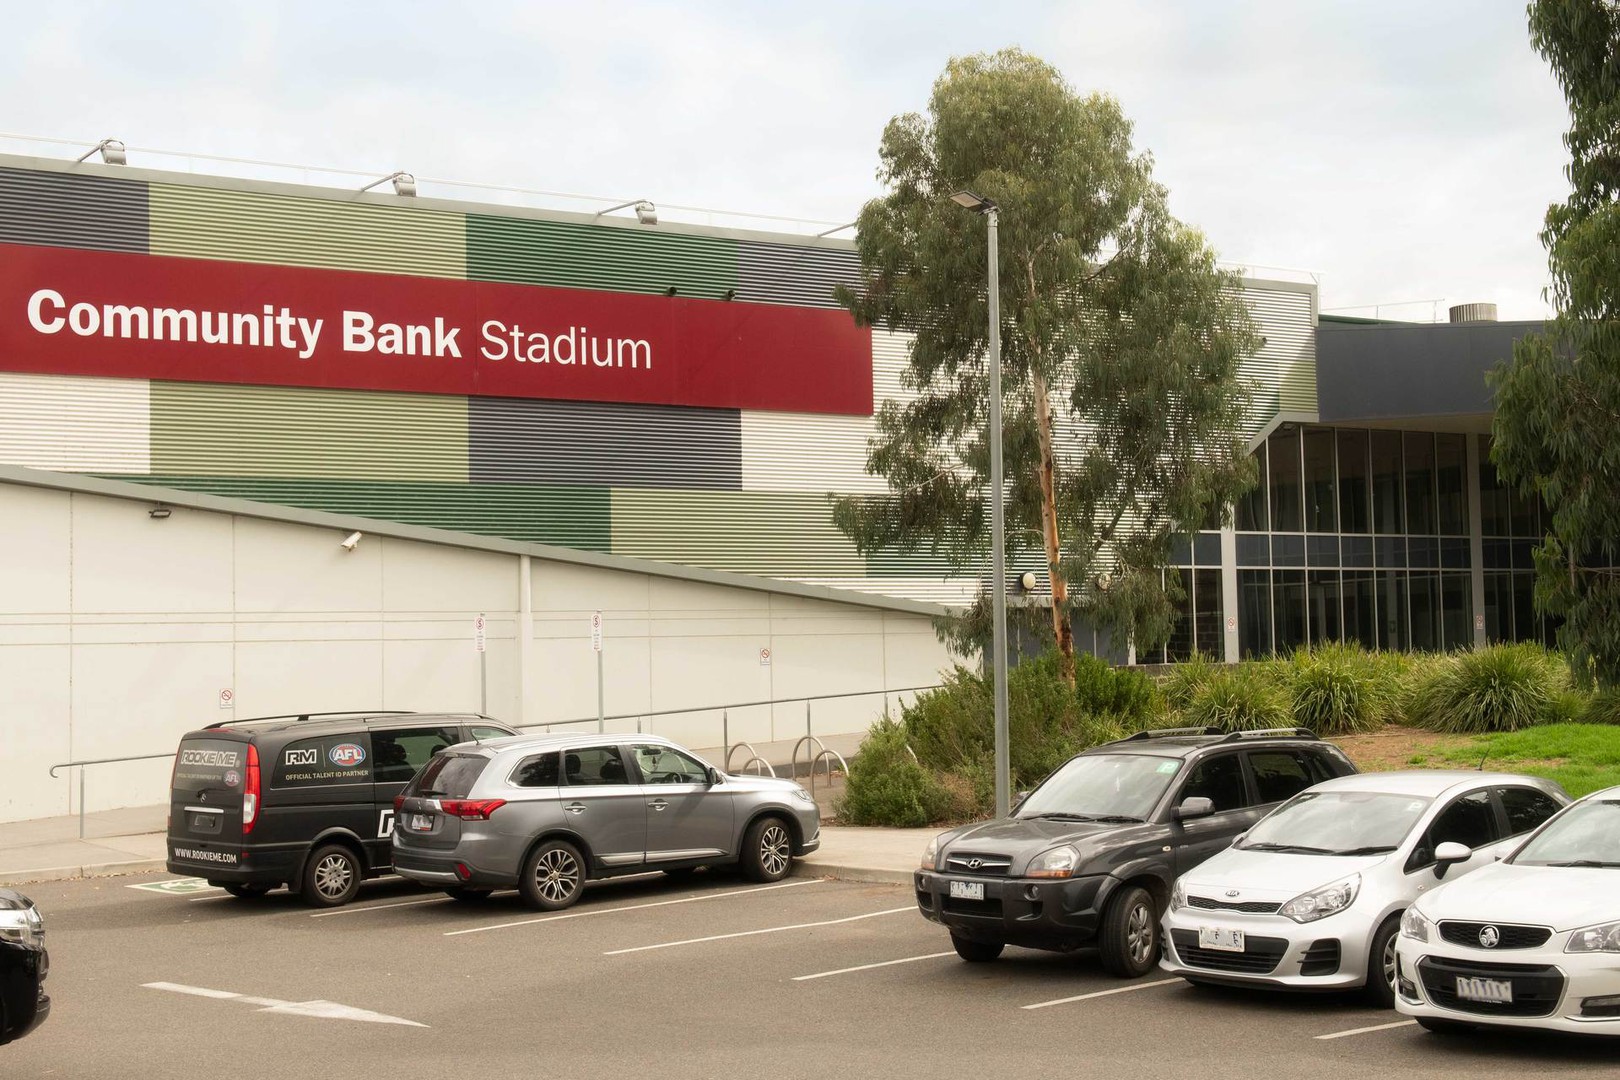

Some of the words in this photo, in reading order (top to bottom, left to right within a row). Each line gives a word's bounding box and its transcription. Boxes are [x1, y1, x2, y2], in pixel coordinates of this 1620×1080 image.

[27, 288, 324, 359] Community
[342, 309, 463, 358] Bank
[480, 319, 652, 369] Stadium
[181, 750, 218, 766] ROOKIE
[216, 751, 238, 767] ME
[285, 749, 317, 766] RM
[333, 749, 363, 761] AFL
[223, 774, 239, 783] AFL
[285, 773, 312, 781] OFFICIAL
[342, 769, 369, 777] PARTNER
[174, 847, 237, 863] WWW.ROOKIEME.COM
